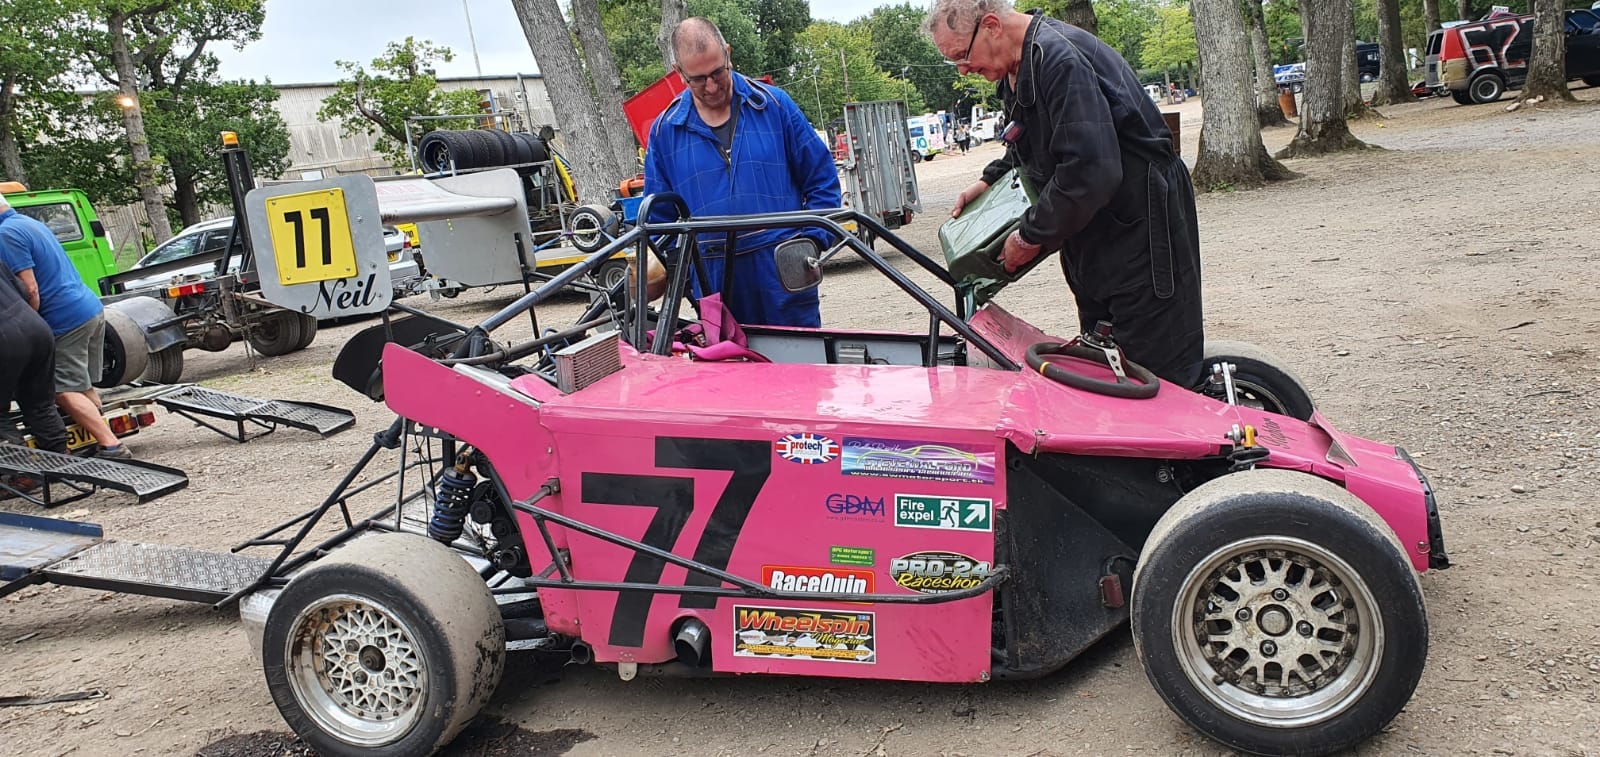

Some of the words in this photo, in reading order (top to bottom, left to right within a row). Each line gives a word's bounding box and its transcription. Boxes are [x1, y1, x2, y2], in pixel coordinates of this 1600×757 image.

[283, 207, 333, 269] 11
[301, 273, 377, 314] Neil
[791, 441, 823, 456] protech
[826, 493, 885, 517] GDM
[900, 499, 926, 511] Fire
[900, 510, 935, 523] expel
[581, 436, 772, 649] 77
[891, 559, 990, 580] PRO-24
[739, 609, 871, 636] Wheelspin
[811, 632, 866, 649] Magazine
